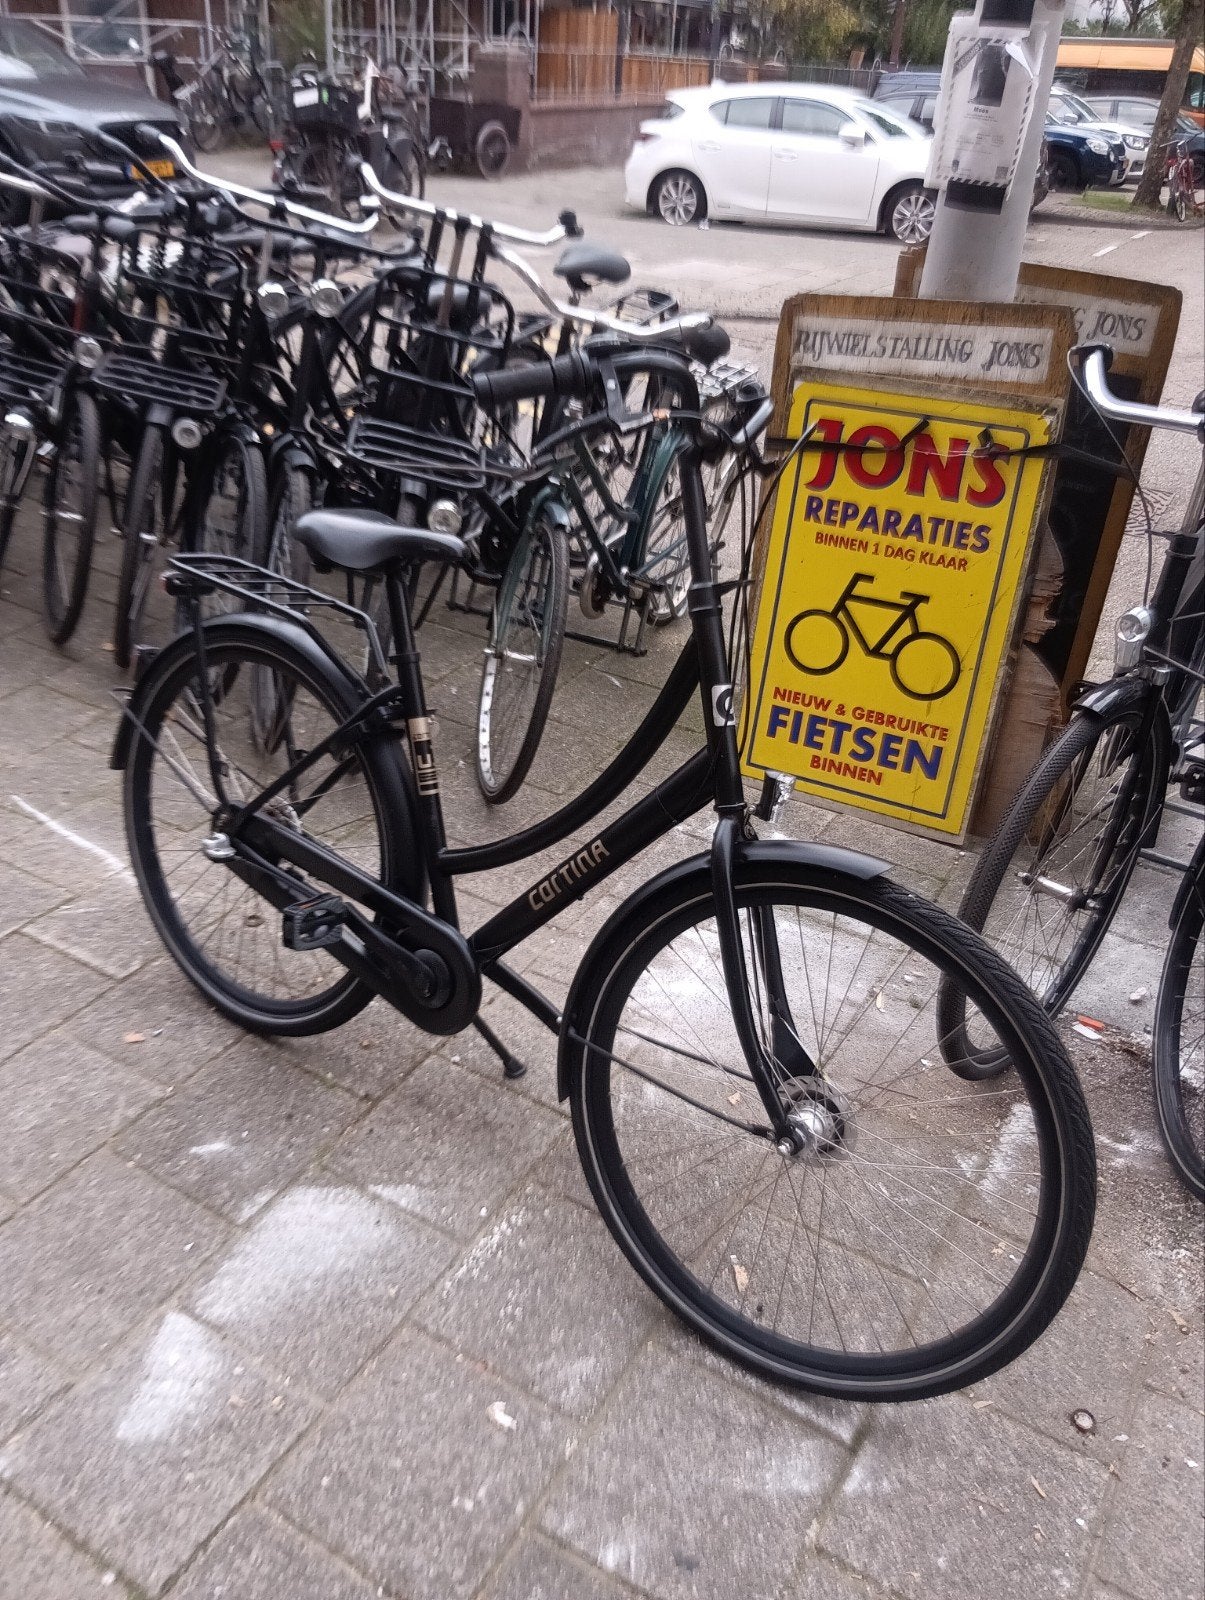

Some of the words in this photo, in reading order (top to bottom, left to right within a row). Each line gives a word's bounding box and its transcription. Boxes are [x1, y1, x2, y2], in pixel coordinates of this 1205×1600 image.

[1086, 310, 1147, 342] JONS
[795, 330, 973, 364] RIJWIELSTALLING
[981, 340, 1043, 371] JONS
[805, 418, 1011, 509] JONS
[803, 495, 991, 554] REPARATIES
[815, 532, 869, 554] BINNEN
[872, 542, 880, 556] 1
[884, 545, 916, 563] DAG
[919, 551, 969, 573] KLAAR
[773, 686, 832, 712] NIEUW
[835, 703, 846, 717] &
[851, 706, 949, 742] GEBRUIKTE
[766, 704, 944, 781] FIETSEN
[810, 754, 883, 787] BINNEN
